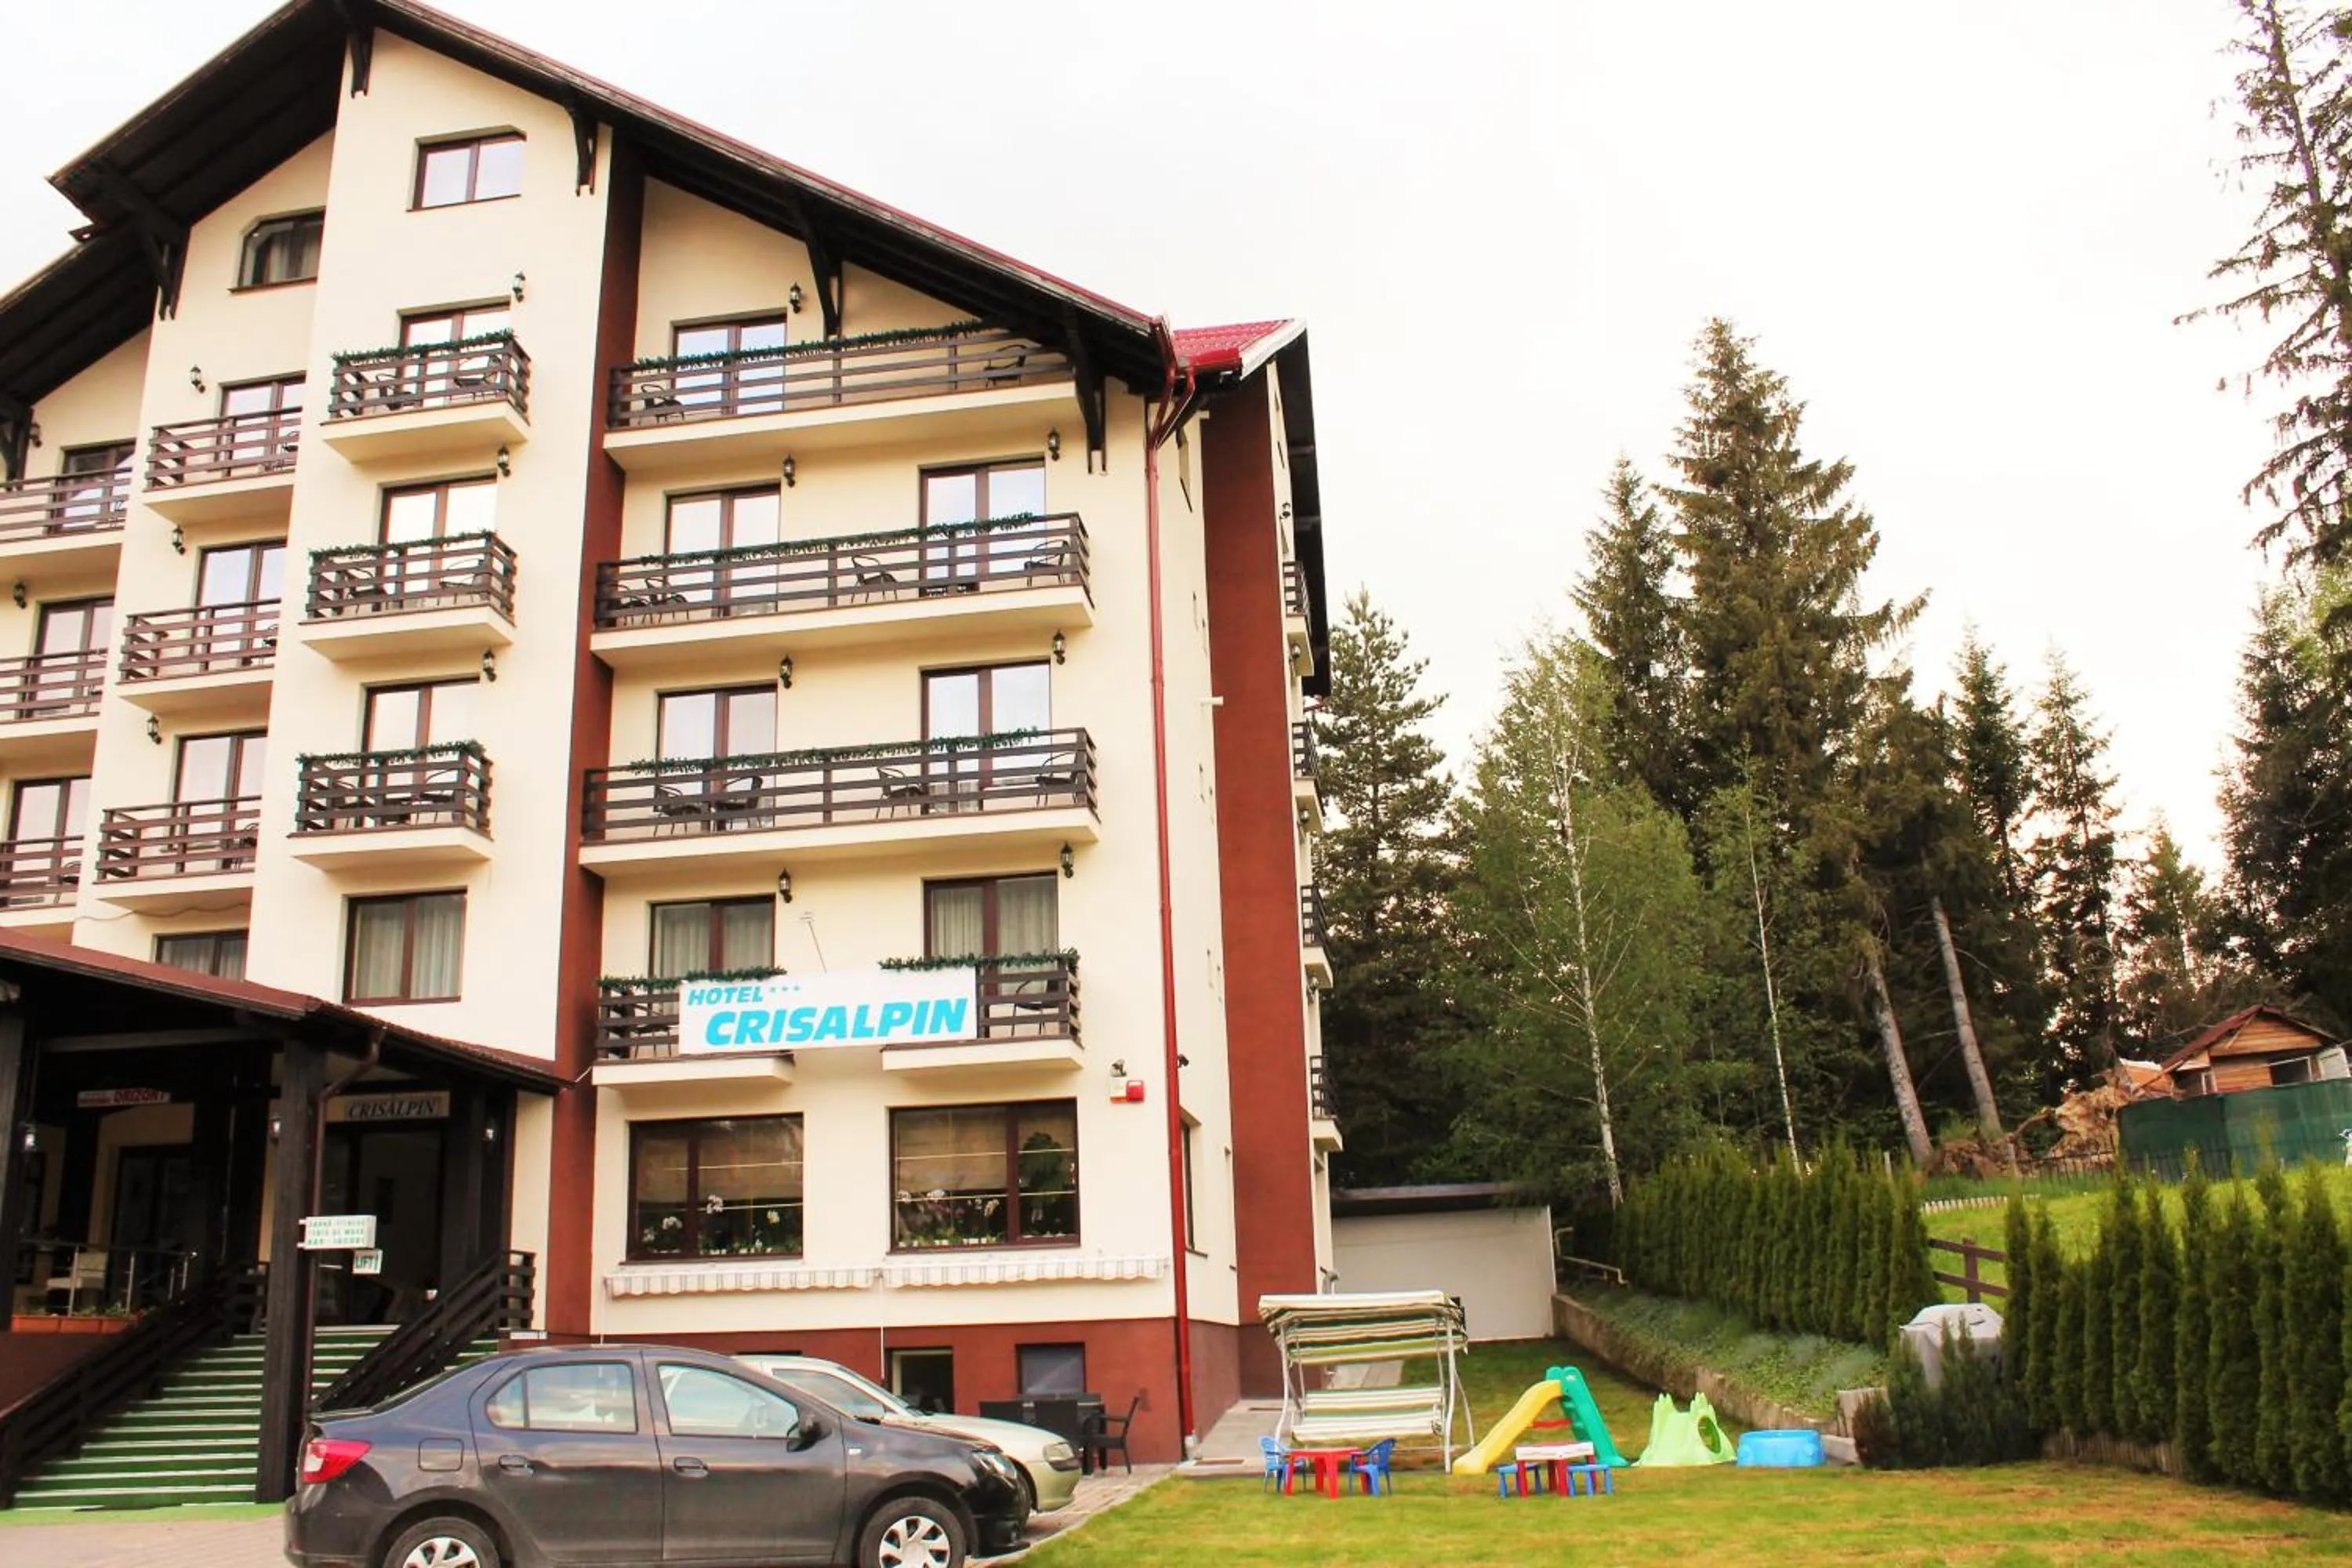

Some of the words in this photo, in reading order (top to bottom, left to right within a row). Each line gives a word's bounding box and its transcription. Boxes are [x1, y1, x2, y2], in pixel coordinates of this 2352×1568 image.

[688, 985, 764, 1006] HOTEL
[705, 998, 968, 1047] CRISALPIN
[347, 1099, 437, 1119] CRISALPIN
